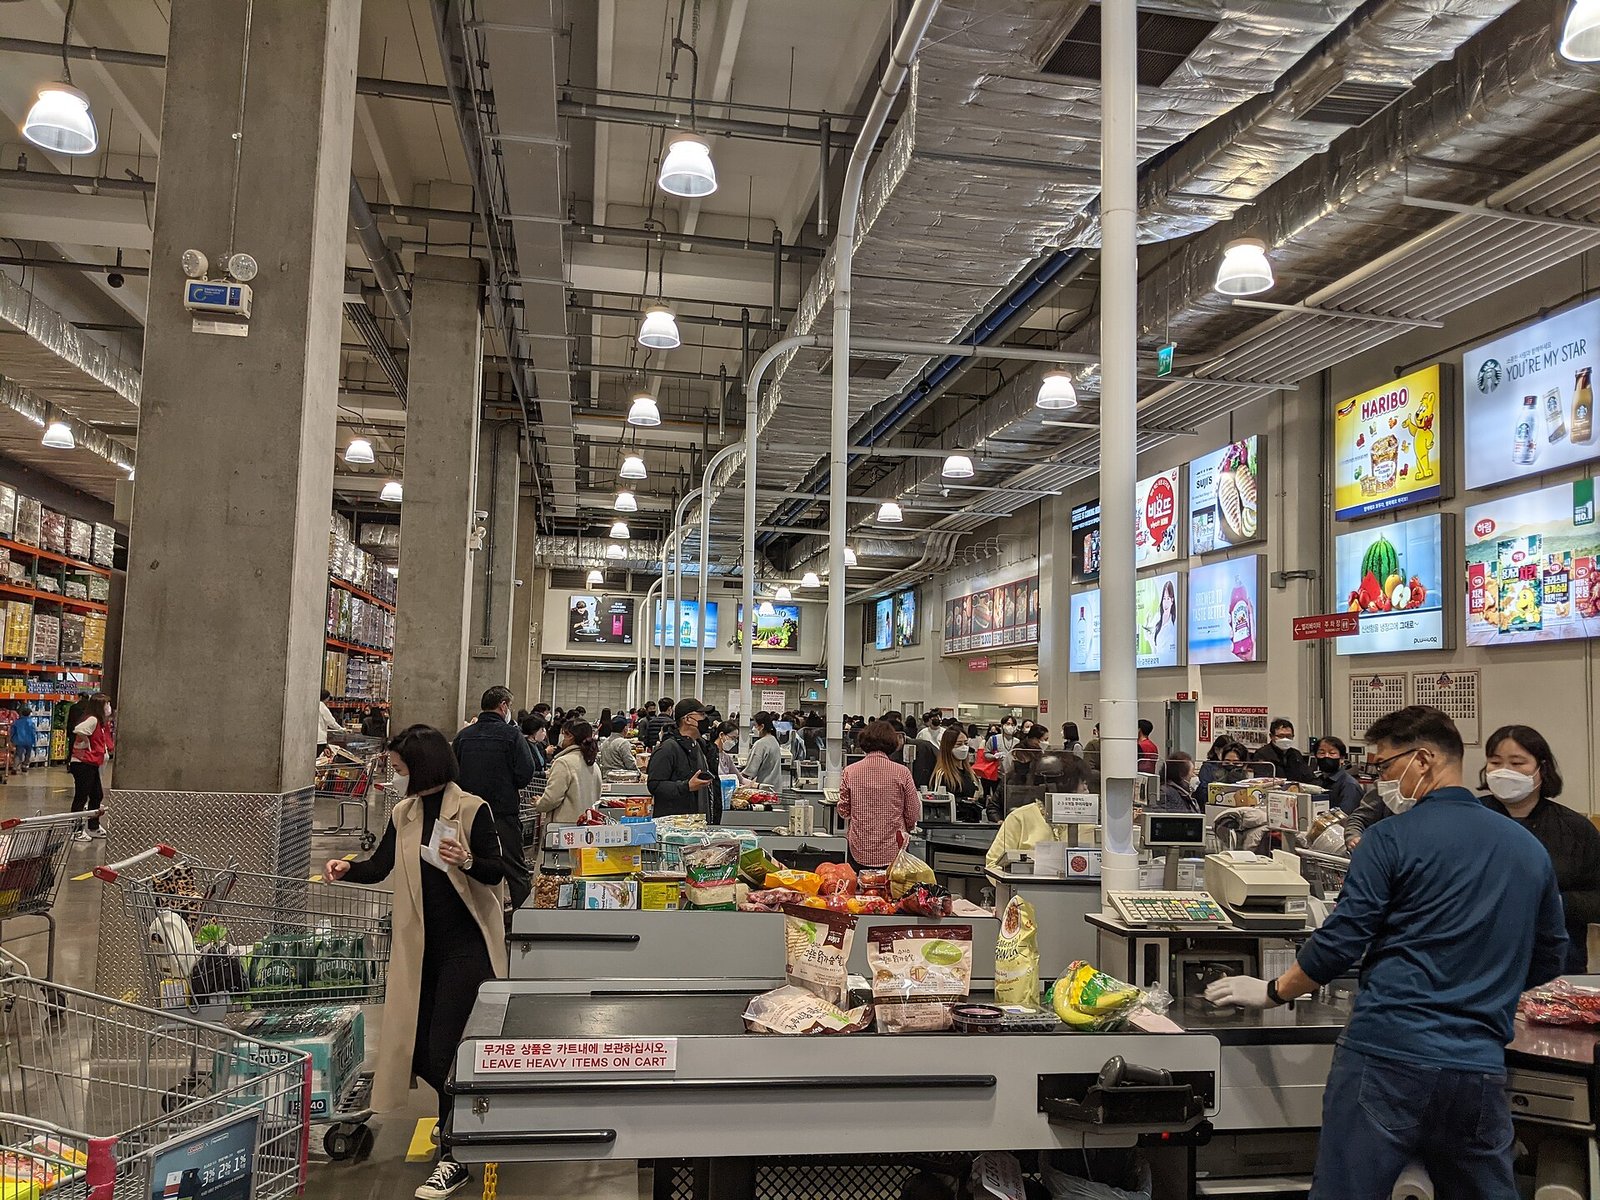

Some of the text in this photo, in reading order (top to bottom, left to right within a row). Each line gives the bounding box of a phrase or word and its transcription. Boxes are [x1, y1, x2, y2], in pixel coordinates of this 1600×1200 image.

[1506, 338, 1587, 382] YOU'RE MY STAR
[1361, 388, 1408, 421] HARIBO
[1477, 521, 1492, 534] 하림
[484, 1042, 668, 1056] 무거운 상품은 카트내에 보관하십시오.
[482, 1056, 667, 1069] LEAVE HEAVY ITEMS ON CART
